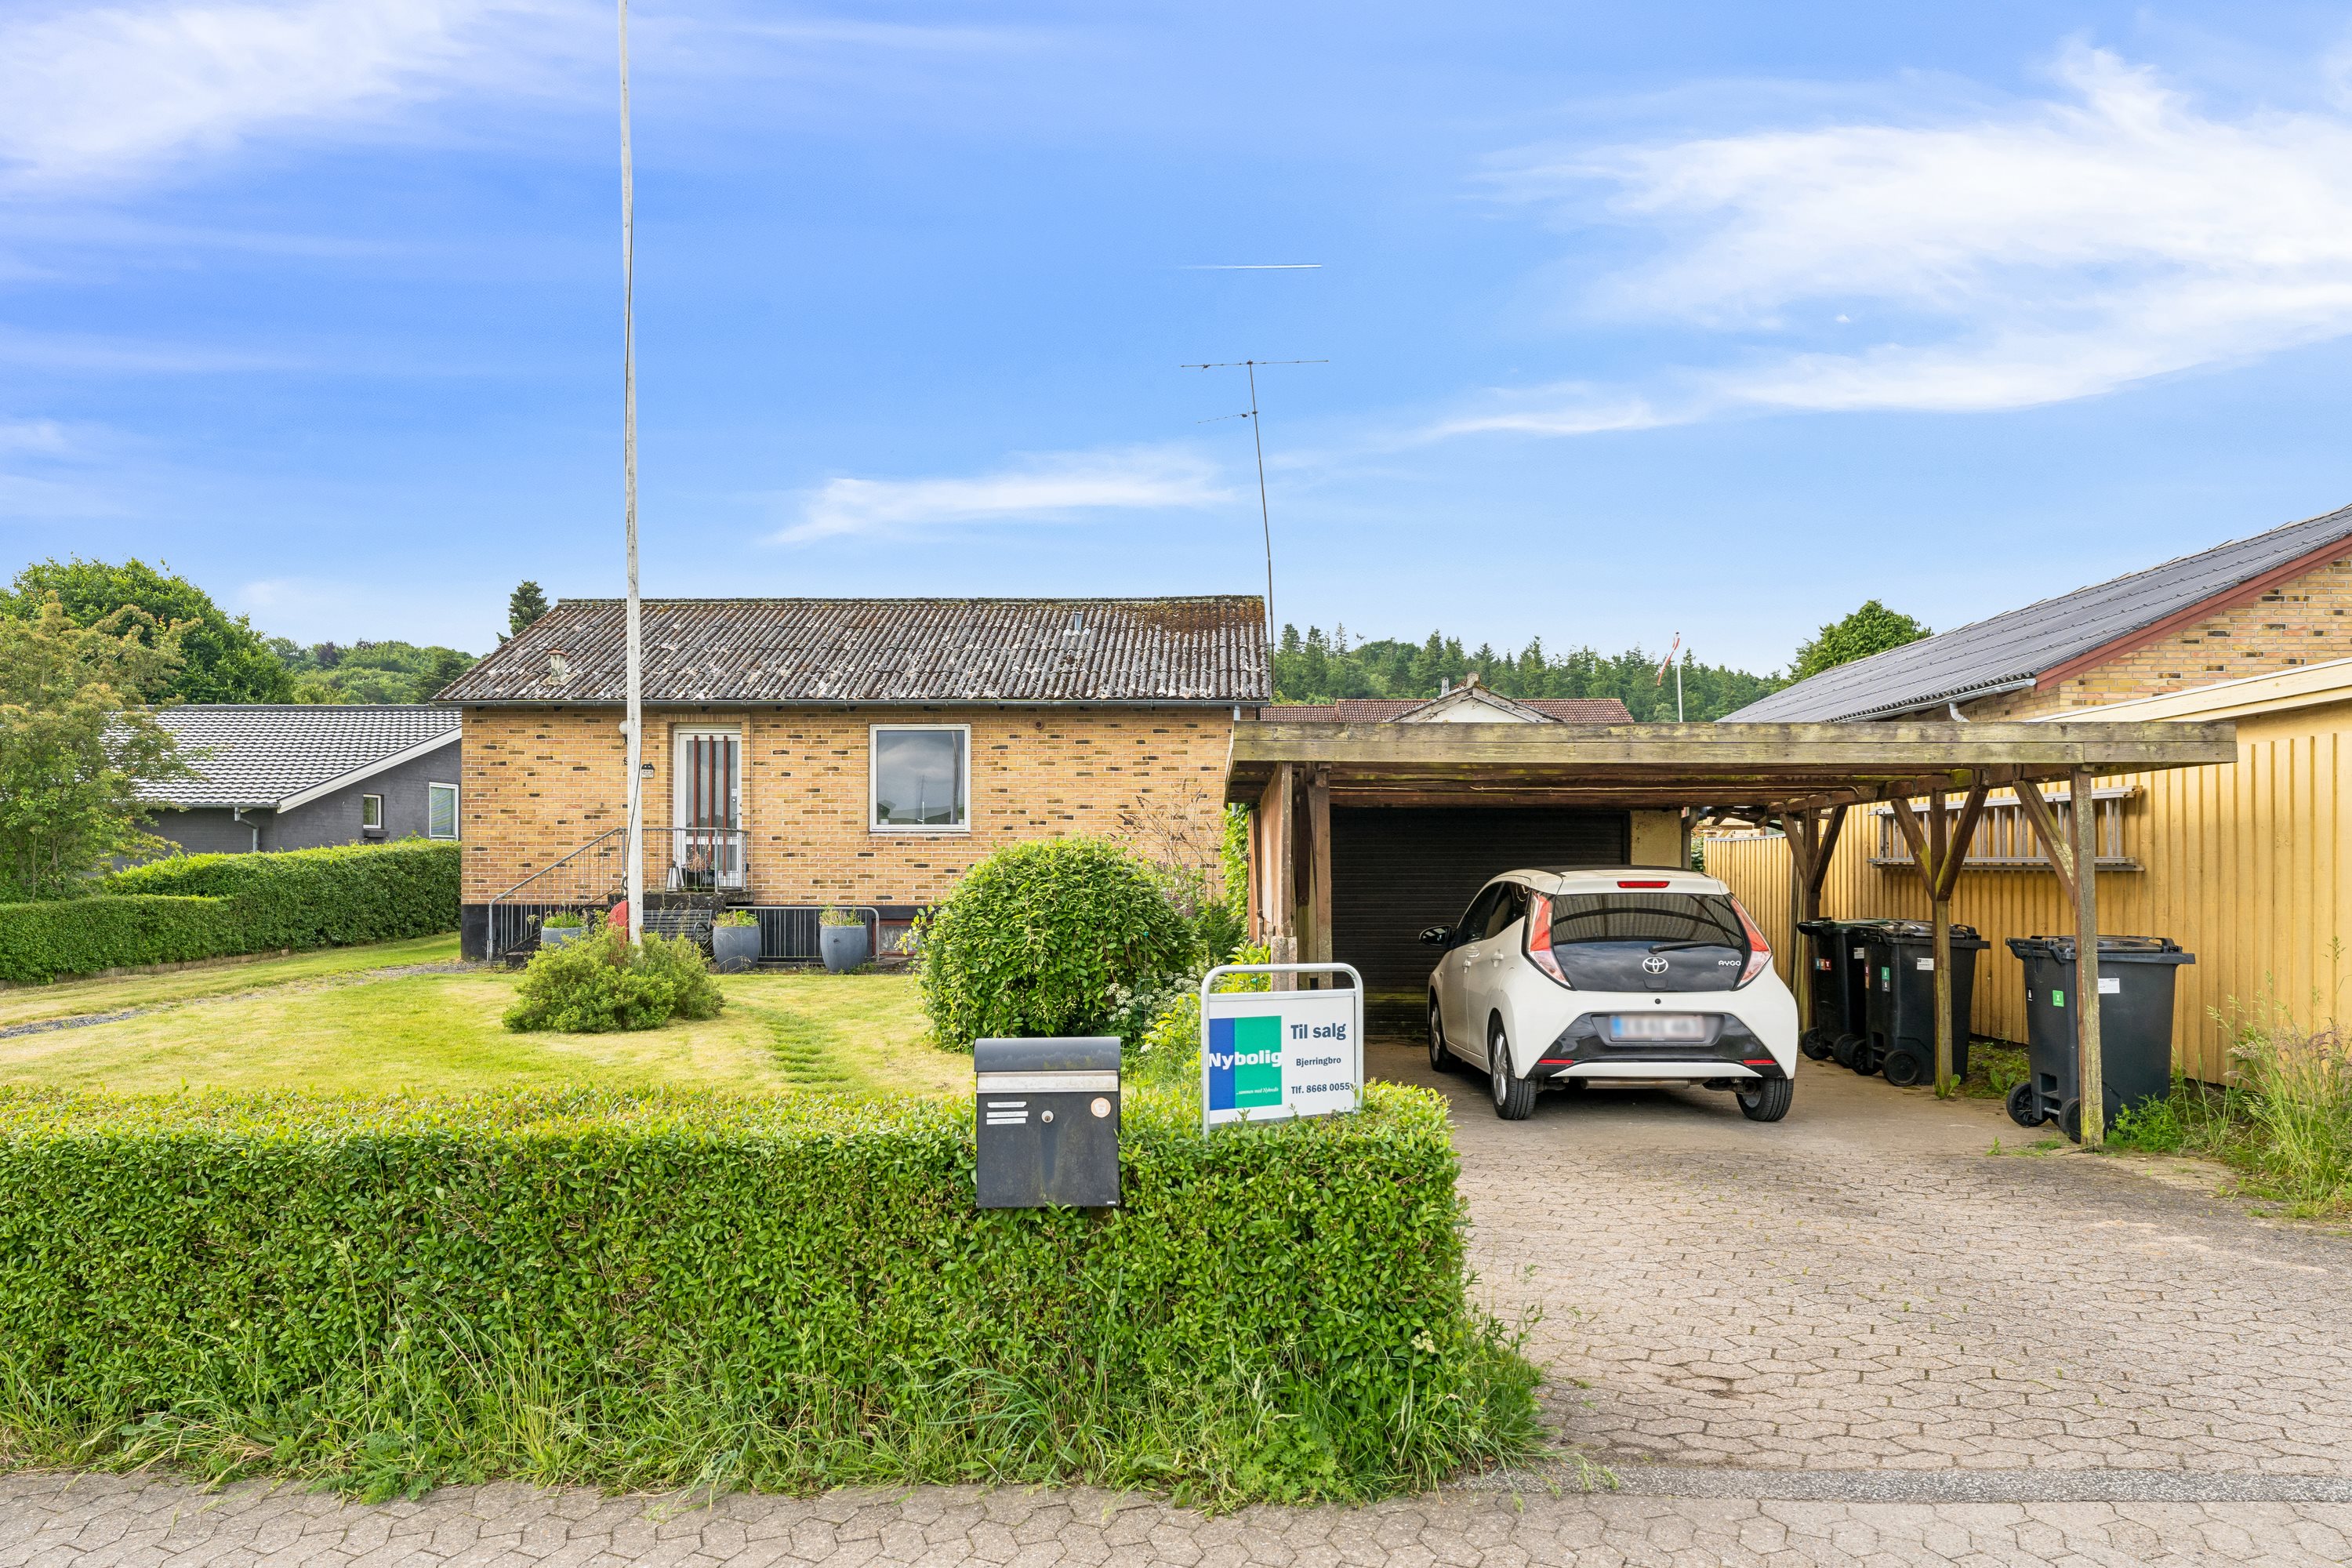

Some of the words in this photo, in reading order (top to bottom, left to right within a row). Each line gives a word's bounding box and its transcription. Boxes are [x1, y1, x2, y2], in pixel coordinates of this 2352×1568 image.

[1290, 1023, 1308, 1040] Til
[1312, 1022, 1346, 1040] salg
[1208, 1049, 1282, 1070] Nybolig
[1296, 1056, 1341, 1068] Bjerringbro
[1290, 1085, 1304, 1094] Tlf.
[1306, 1083, 1327, 1094] 8668
[1329, 1082, 1350, 1091] 0055
